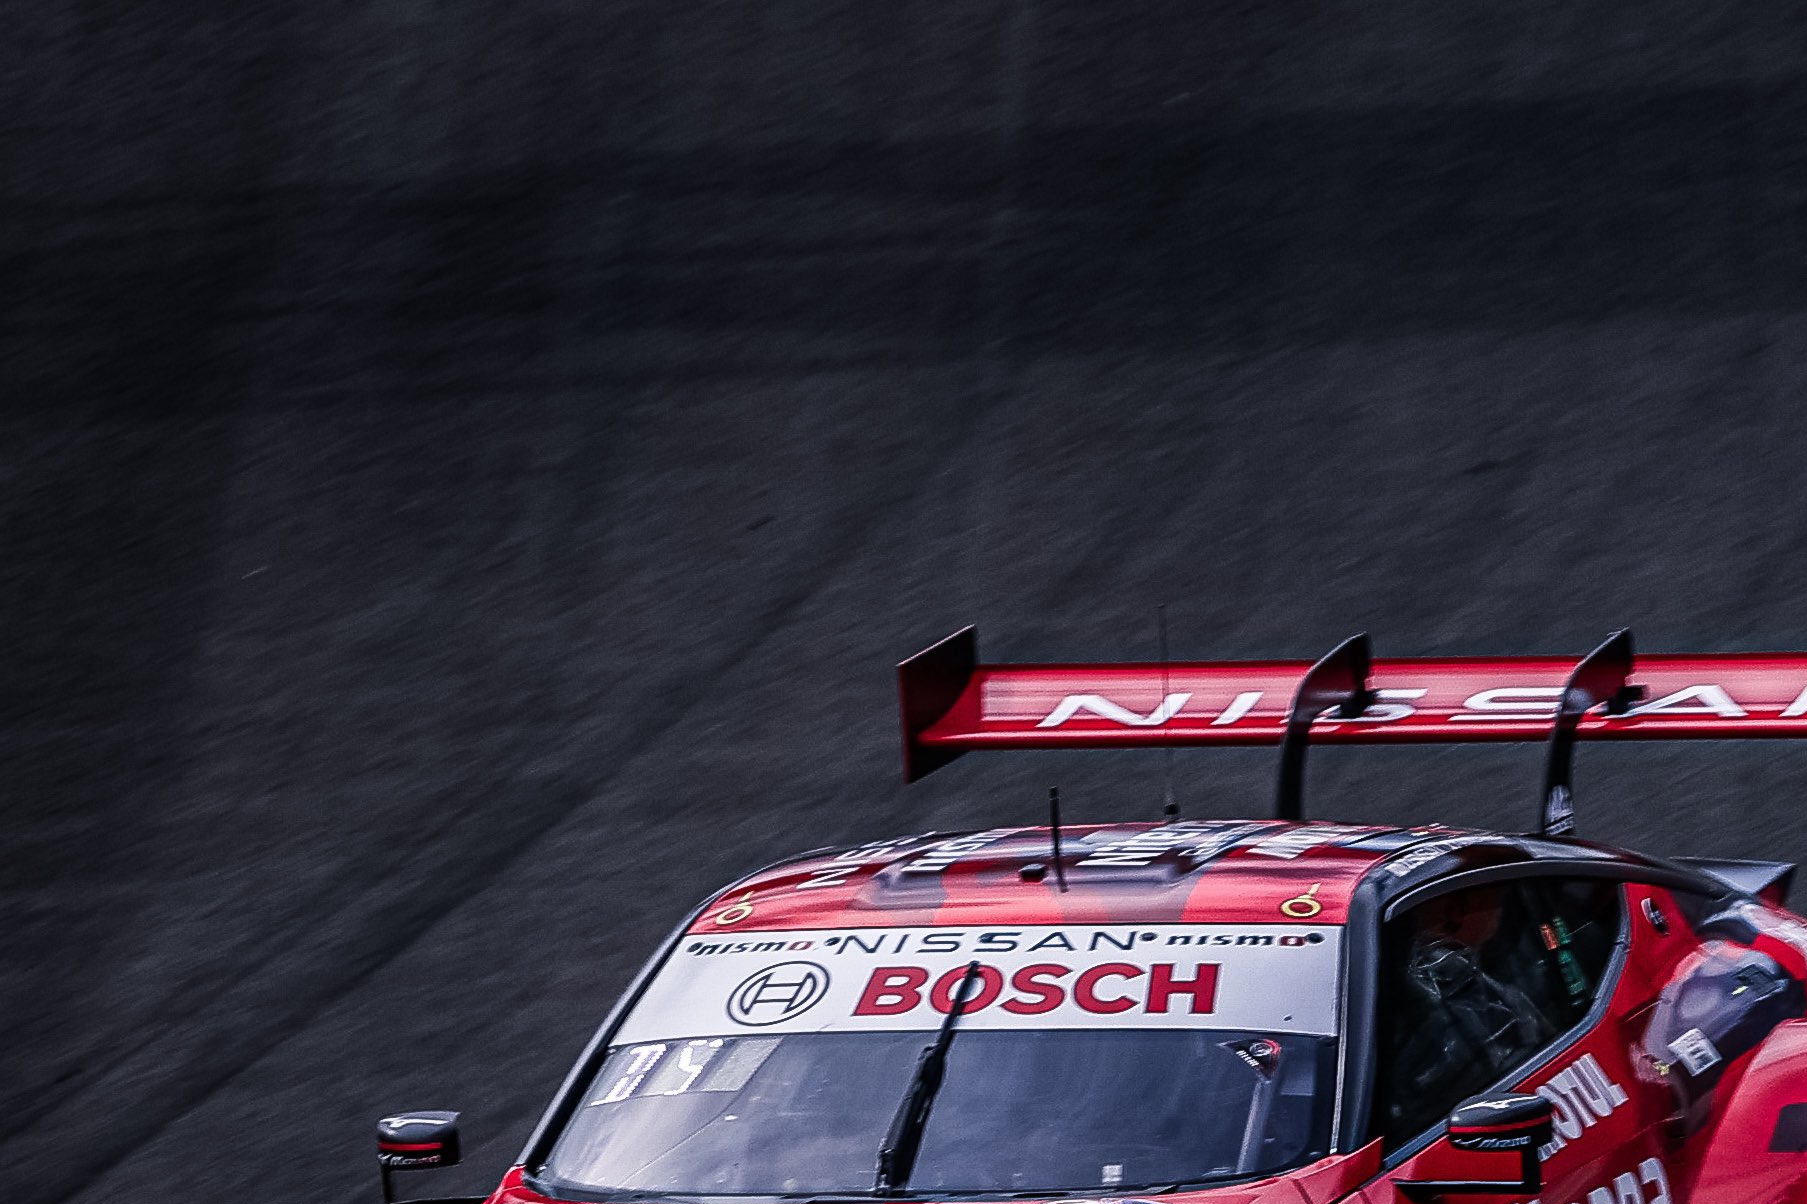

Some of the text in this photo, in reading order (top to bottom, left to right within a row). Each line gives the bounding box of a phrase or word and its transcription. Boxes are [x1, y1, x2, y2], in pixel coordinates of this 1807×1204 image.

[694, 931, 1308, 957] nismo NISSAN nismo
[851, 962, 1222, 1017] BOSCH
[1535, 1053, 1629, 1162] OTUL
